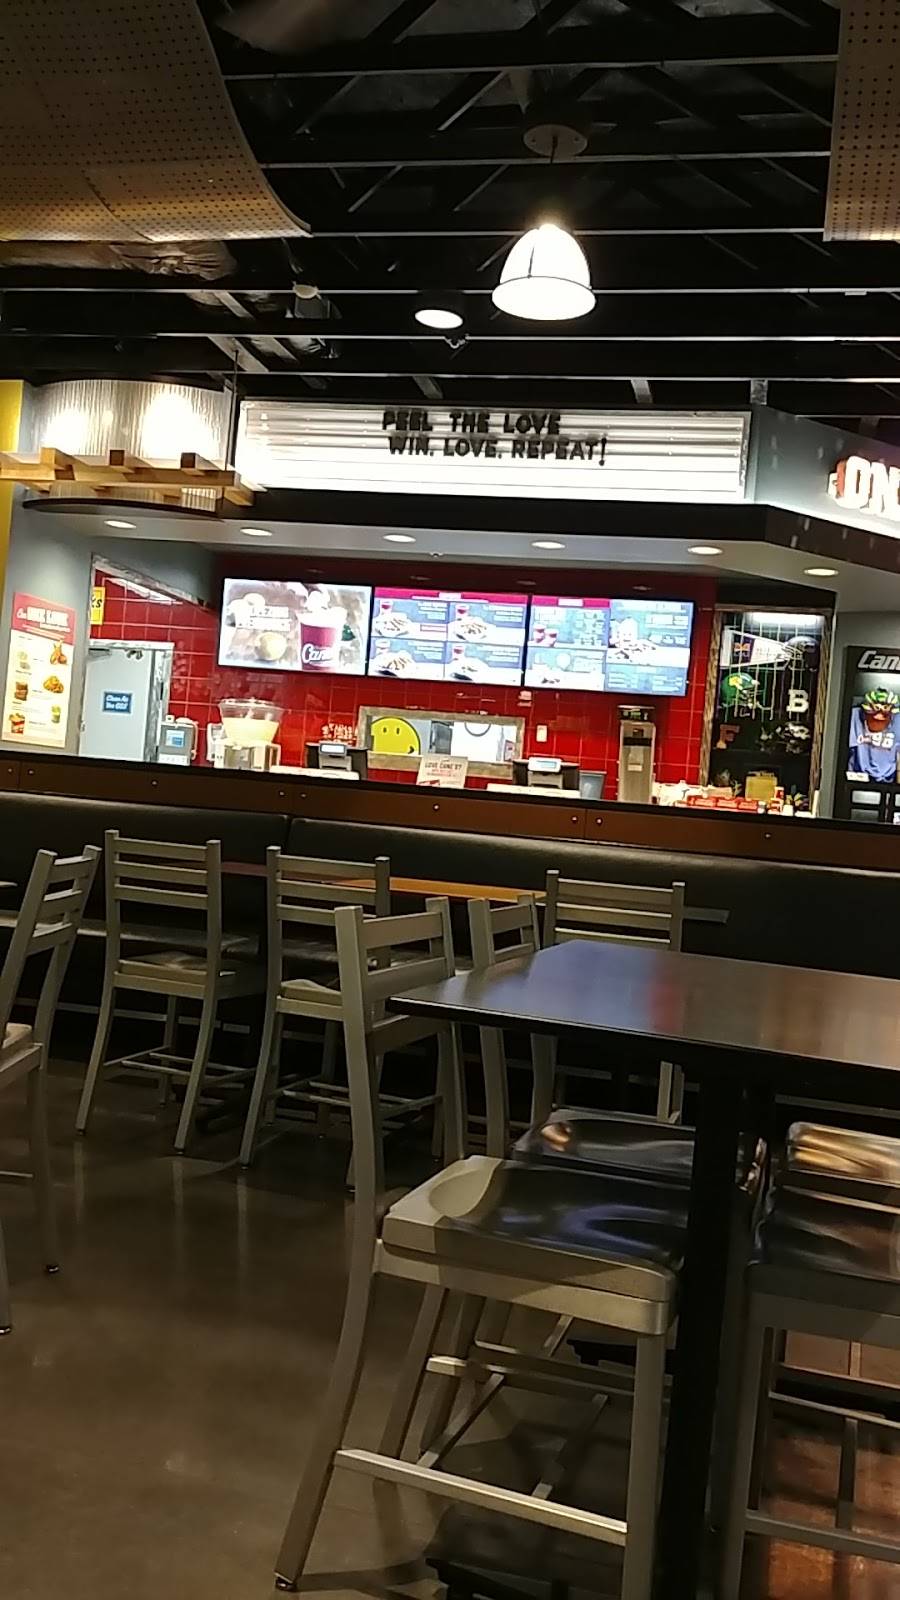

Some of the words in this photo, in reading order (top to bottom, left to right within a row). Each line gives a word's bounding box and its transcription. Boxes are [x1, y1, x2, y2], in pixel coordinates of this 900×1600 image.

[450, 410, 490, 433] THE
[503, 412, 561, 435] LOVE
[511, 438, 607, 466] REPEAT!
[786, 689, 809, 712] B
